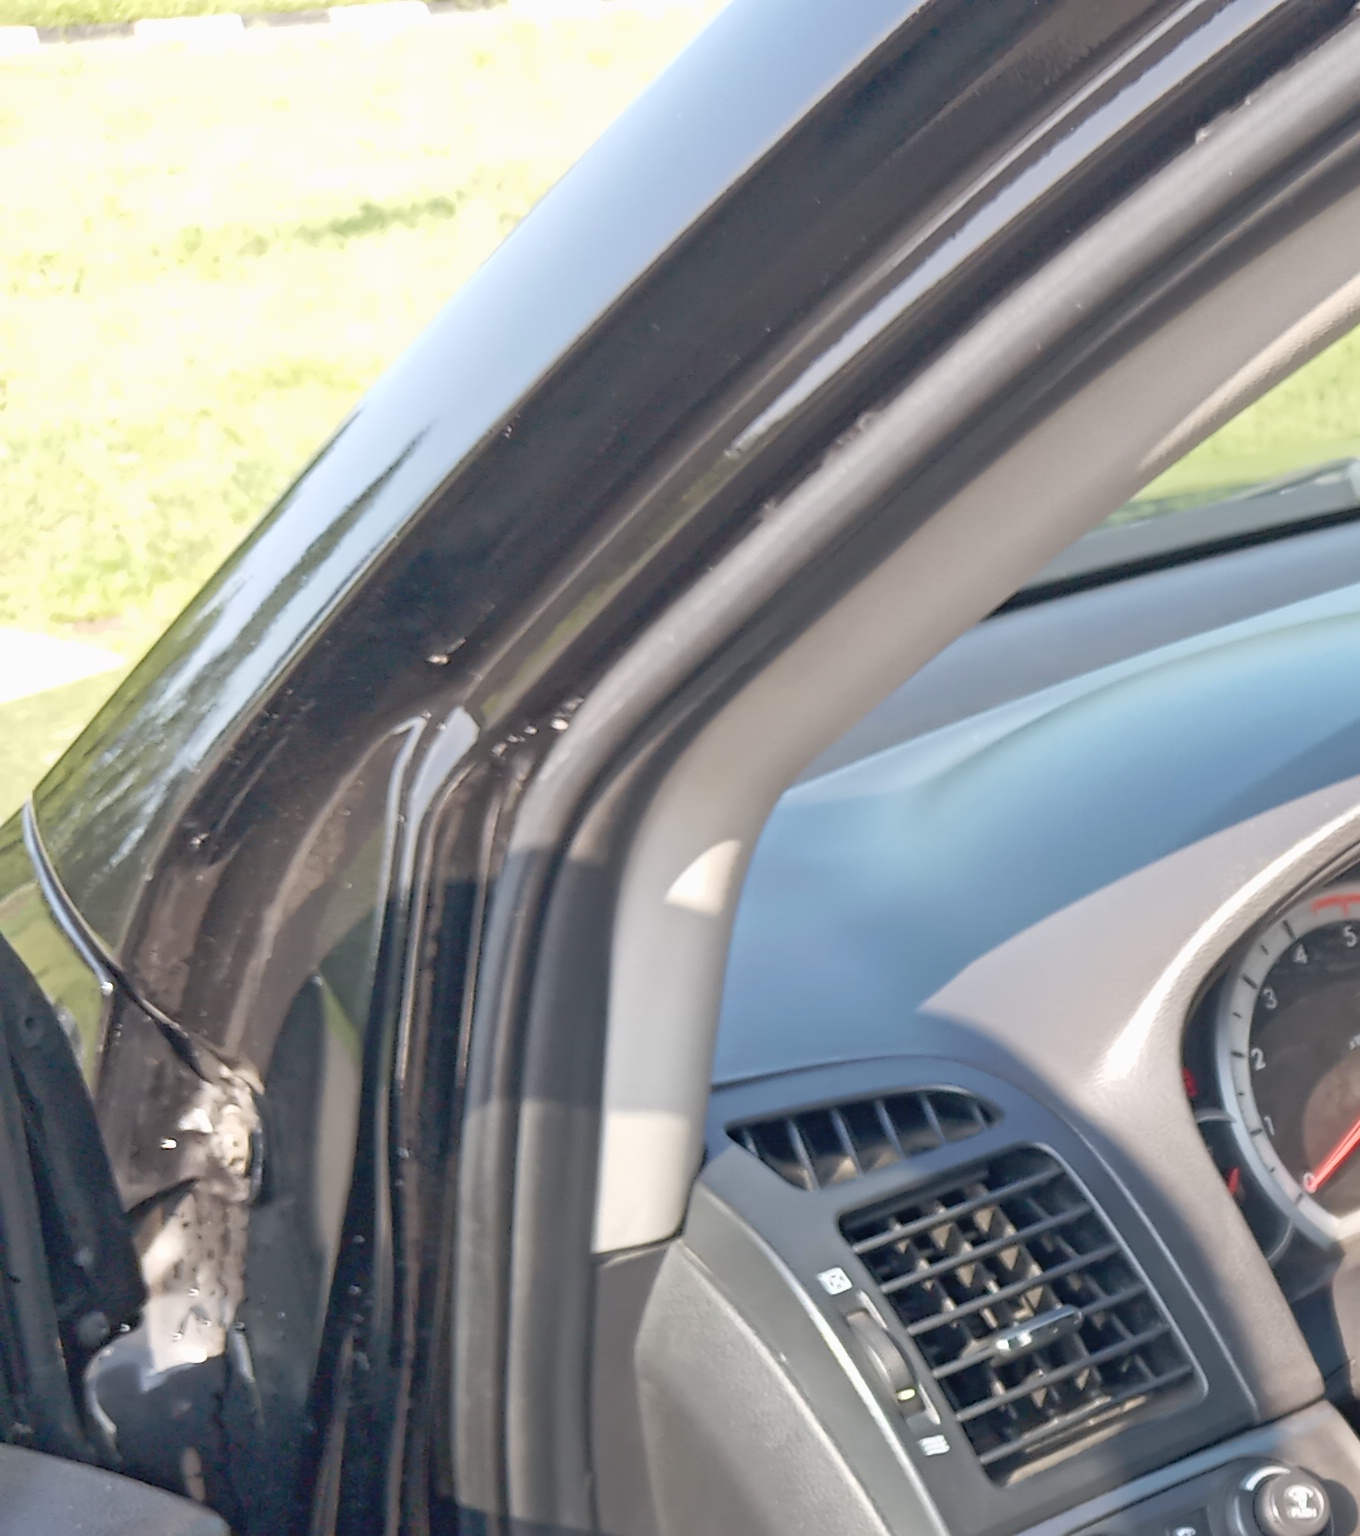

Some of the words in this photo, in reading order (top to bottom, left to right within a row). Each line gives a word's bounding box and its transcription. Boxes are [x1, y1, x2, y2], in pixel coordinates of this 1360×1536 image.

[1342, 925, 1358, 948] 5
[1293, 944, 1308, 964] 4
[1263, 987, 1278, 1010] 3
[1251, 1048, 1266, 1071] 2
[1264, 1116, 1275, 1136] 1
[1303, 1172, 1317, 1193] 0
